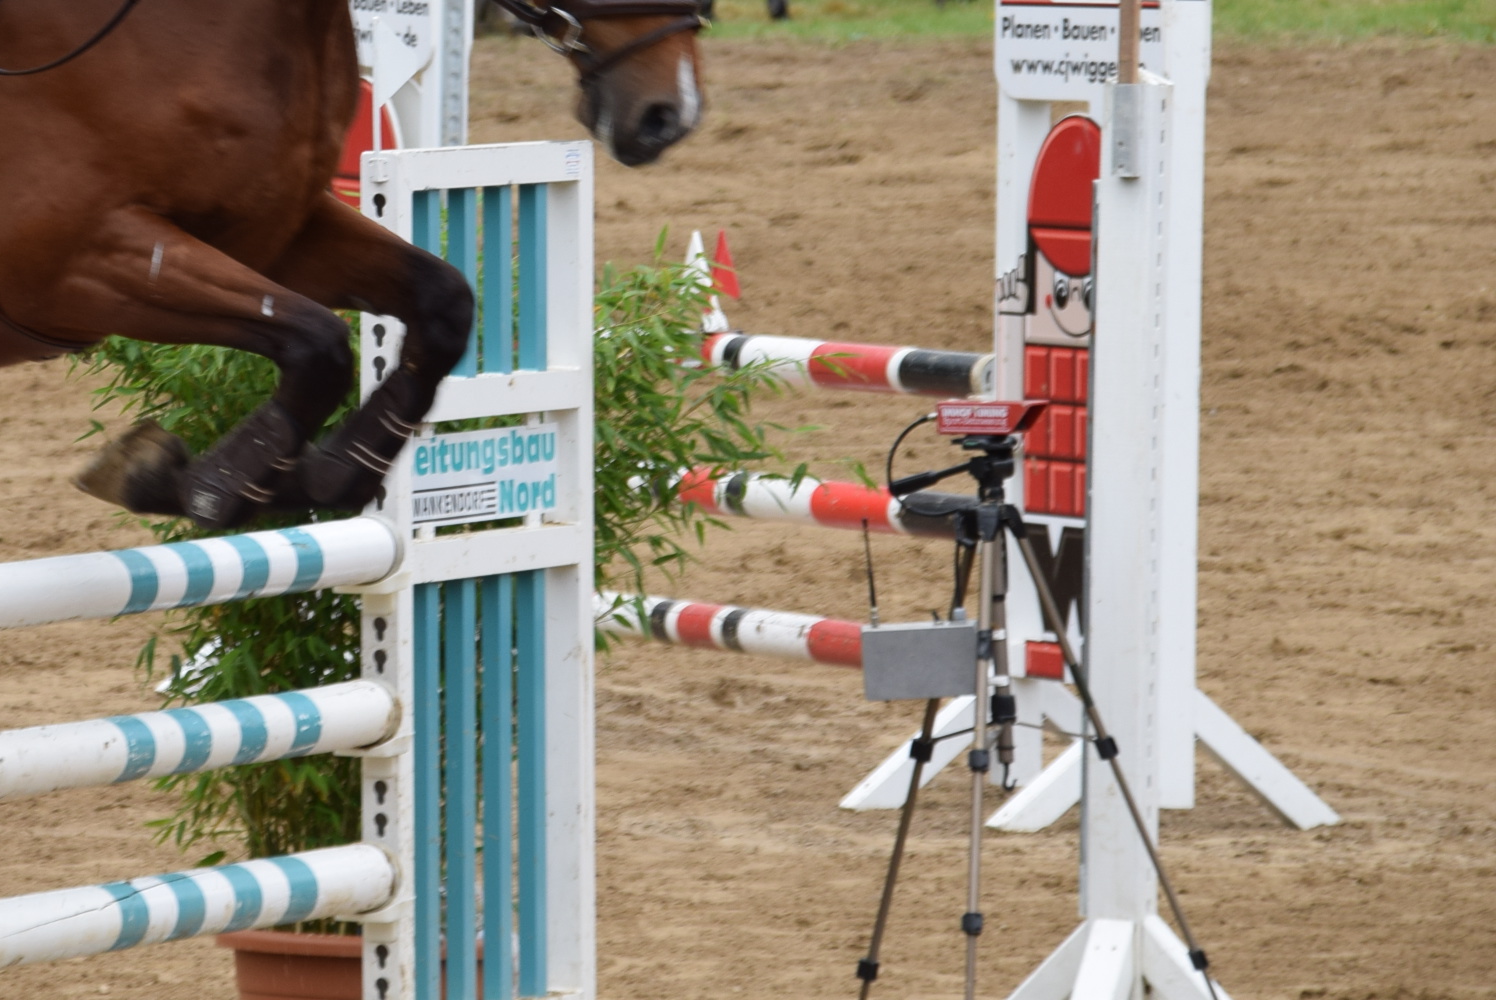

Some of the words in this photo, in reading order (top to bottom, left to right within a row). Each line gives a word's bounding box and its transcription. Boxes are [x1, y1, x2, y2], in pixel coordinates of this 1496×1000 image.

[1001, 16, 1051, 39] Planen
[1061, 18, 1107, 41] Bauen
[414, 430, 555, 476] eitungsbau
[499, 473, 556, 514] Nord
